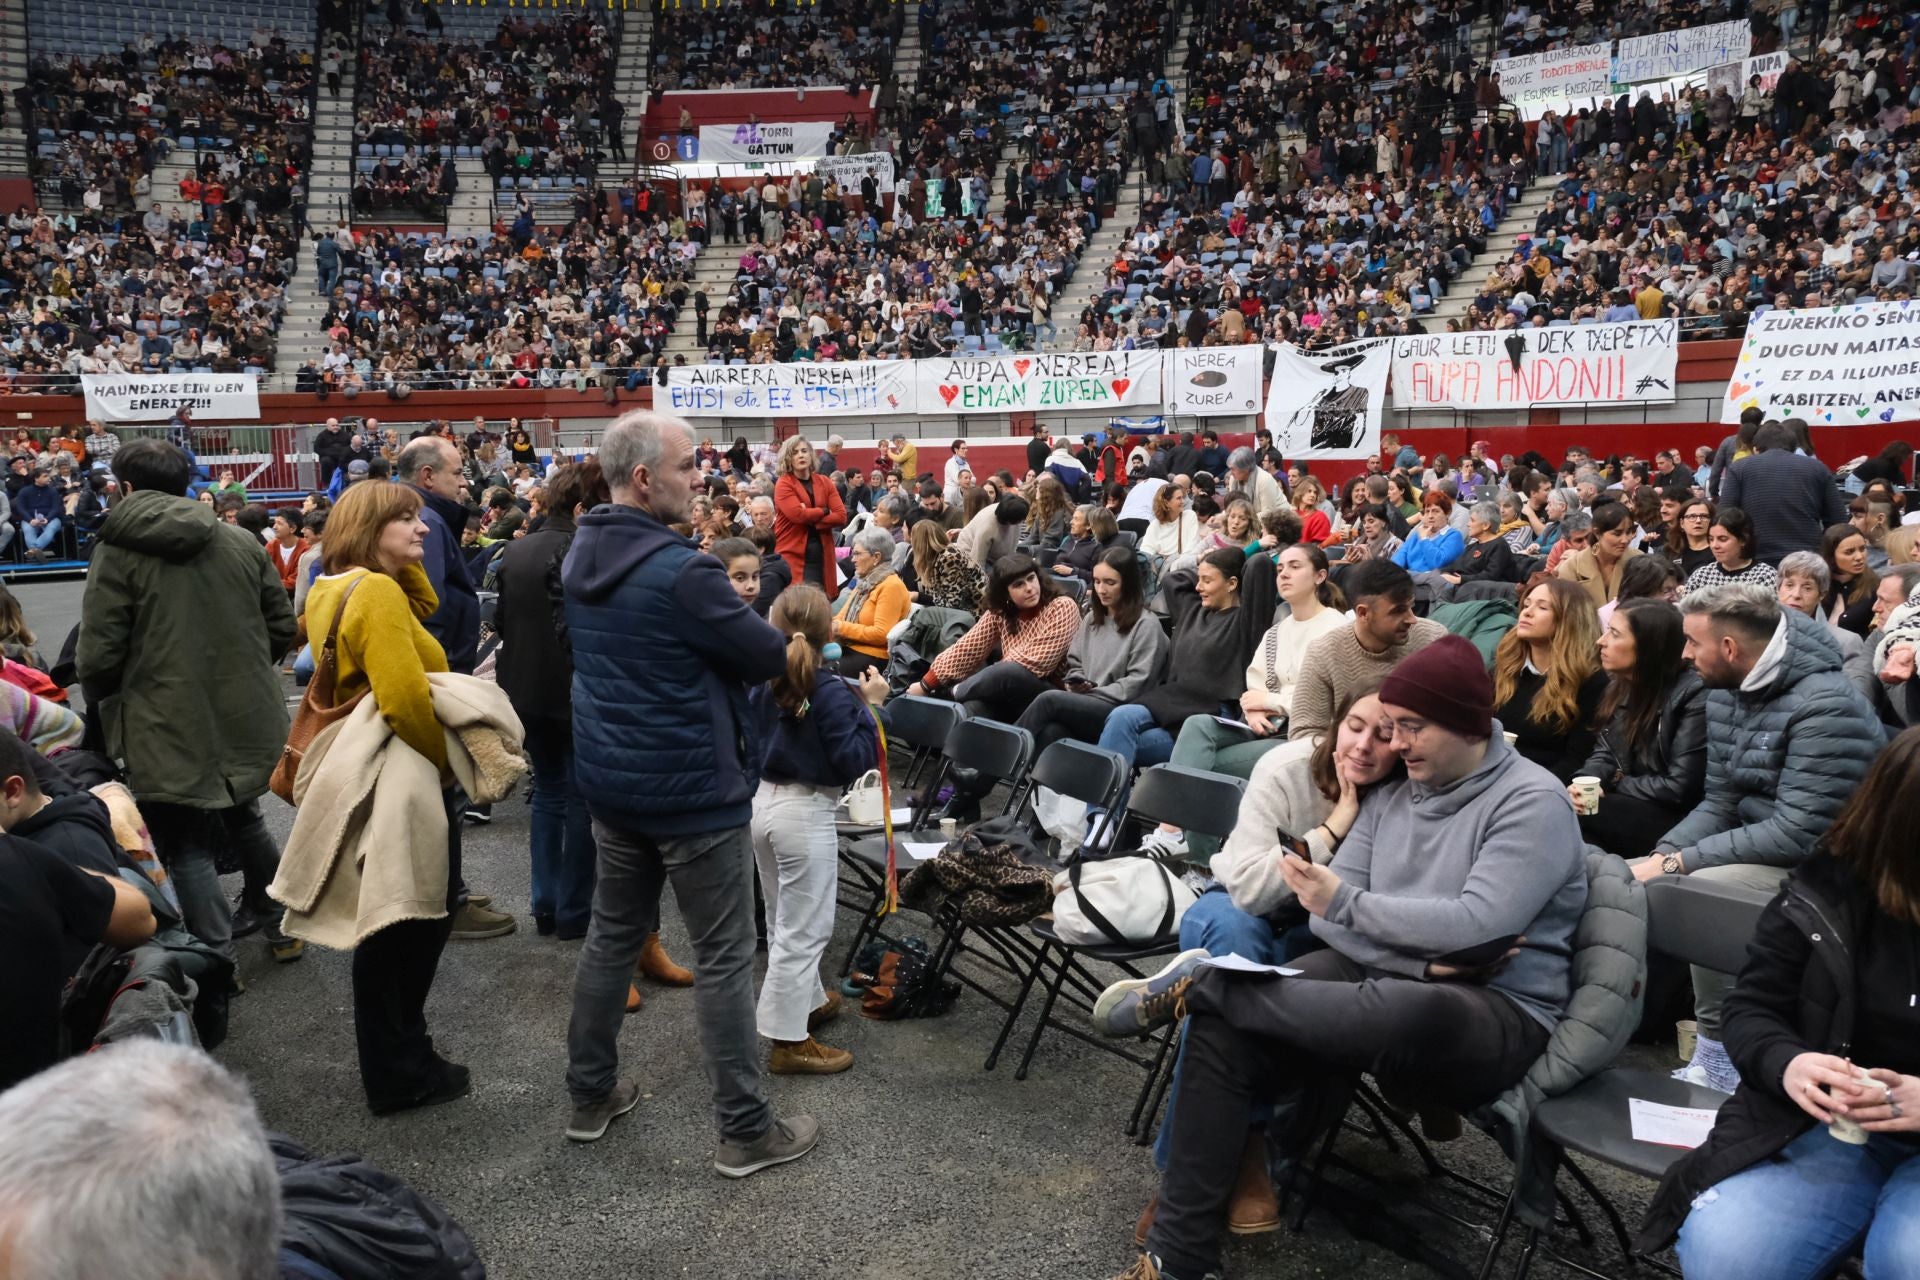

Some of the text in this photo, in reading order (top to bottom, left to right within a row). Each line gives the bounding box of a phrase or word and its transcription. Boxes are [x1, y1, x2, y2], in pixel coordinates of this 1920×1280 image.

[1750, 55, 1782, 75] AUPA
[732, 124, 793, 144] AL TORRI
[1763, 314, 1869, 332] ZUREKIKO
[1398, 337, 1440, 358] GAUR
[1452, 335, 1496, 356] LETU
[1538, 330, 1575, 354] DEK
[1759, 336, 1920, 358] DUGUN MAITAS
[945, 352, 1129, 382] AUPA NEREA!
[1184, 353, 1236, 369] NEREA
[1781, 361, 1920, 381] EZ DA ILLUNBE
[691, 367, 778, 385] AURRERA
[1413, 355, 1624, 403] AUPA ANDONI!
[94, 383, 178, 397] HAUNDIXE
[215, 383, 244, 393] DEN
[769, 387, 793, 408] EZ
[963, 379, 1108, 407] EMAN ZUREA
[1185, 391, 1234, 405] ZUREA
[130, 398, 211, 410] ENERITZ!!!
